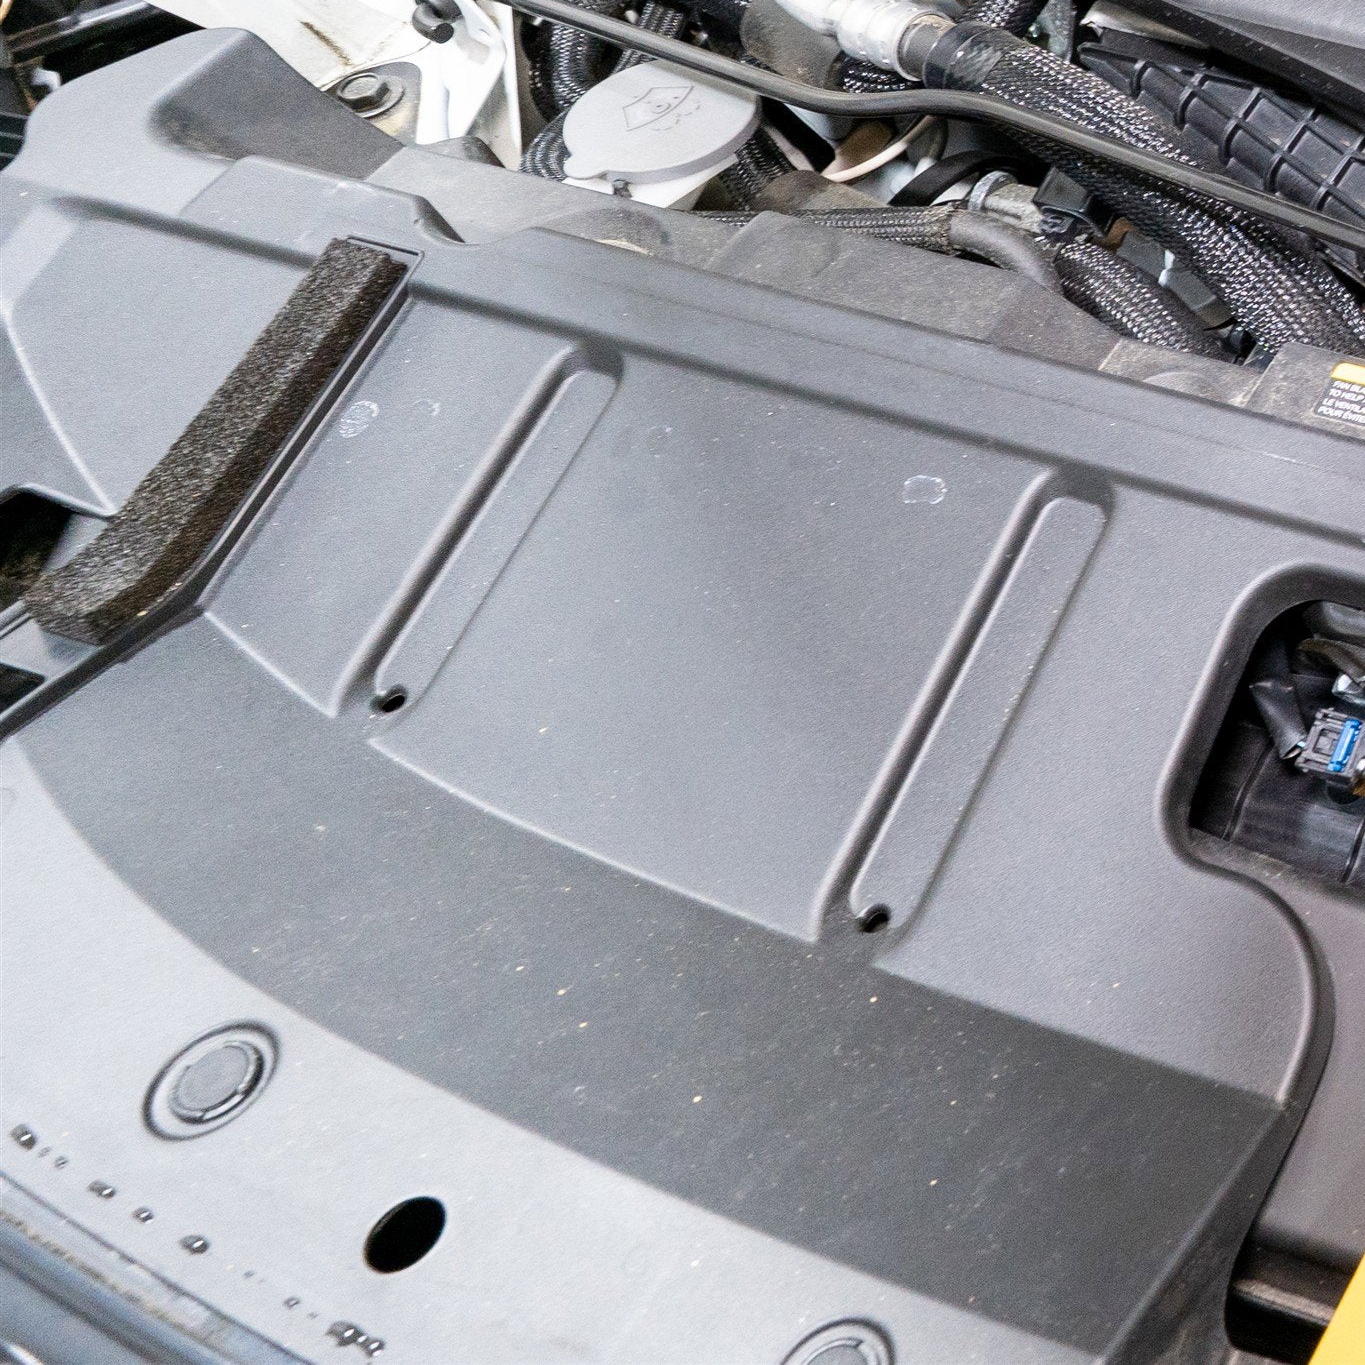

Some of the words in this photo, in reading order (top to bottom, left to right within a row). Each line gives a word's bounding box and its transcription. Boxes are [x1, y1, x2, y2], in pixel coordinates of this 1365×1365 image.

[1332, 379, 1349, 390] FAN
[1322, 396, 1334, 406] LE
[1328, 387, 1341, 398] TO
[1340, 390, 1363, 403] HELP
[1317, 404, 1344, 418] POUR
